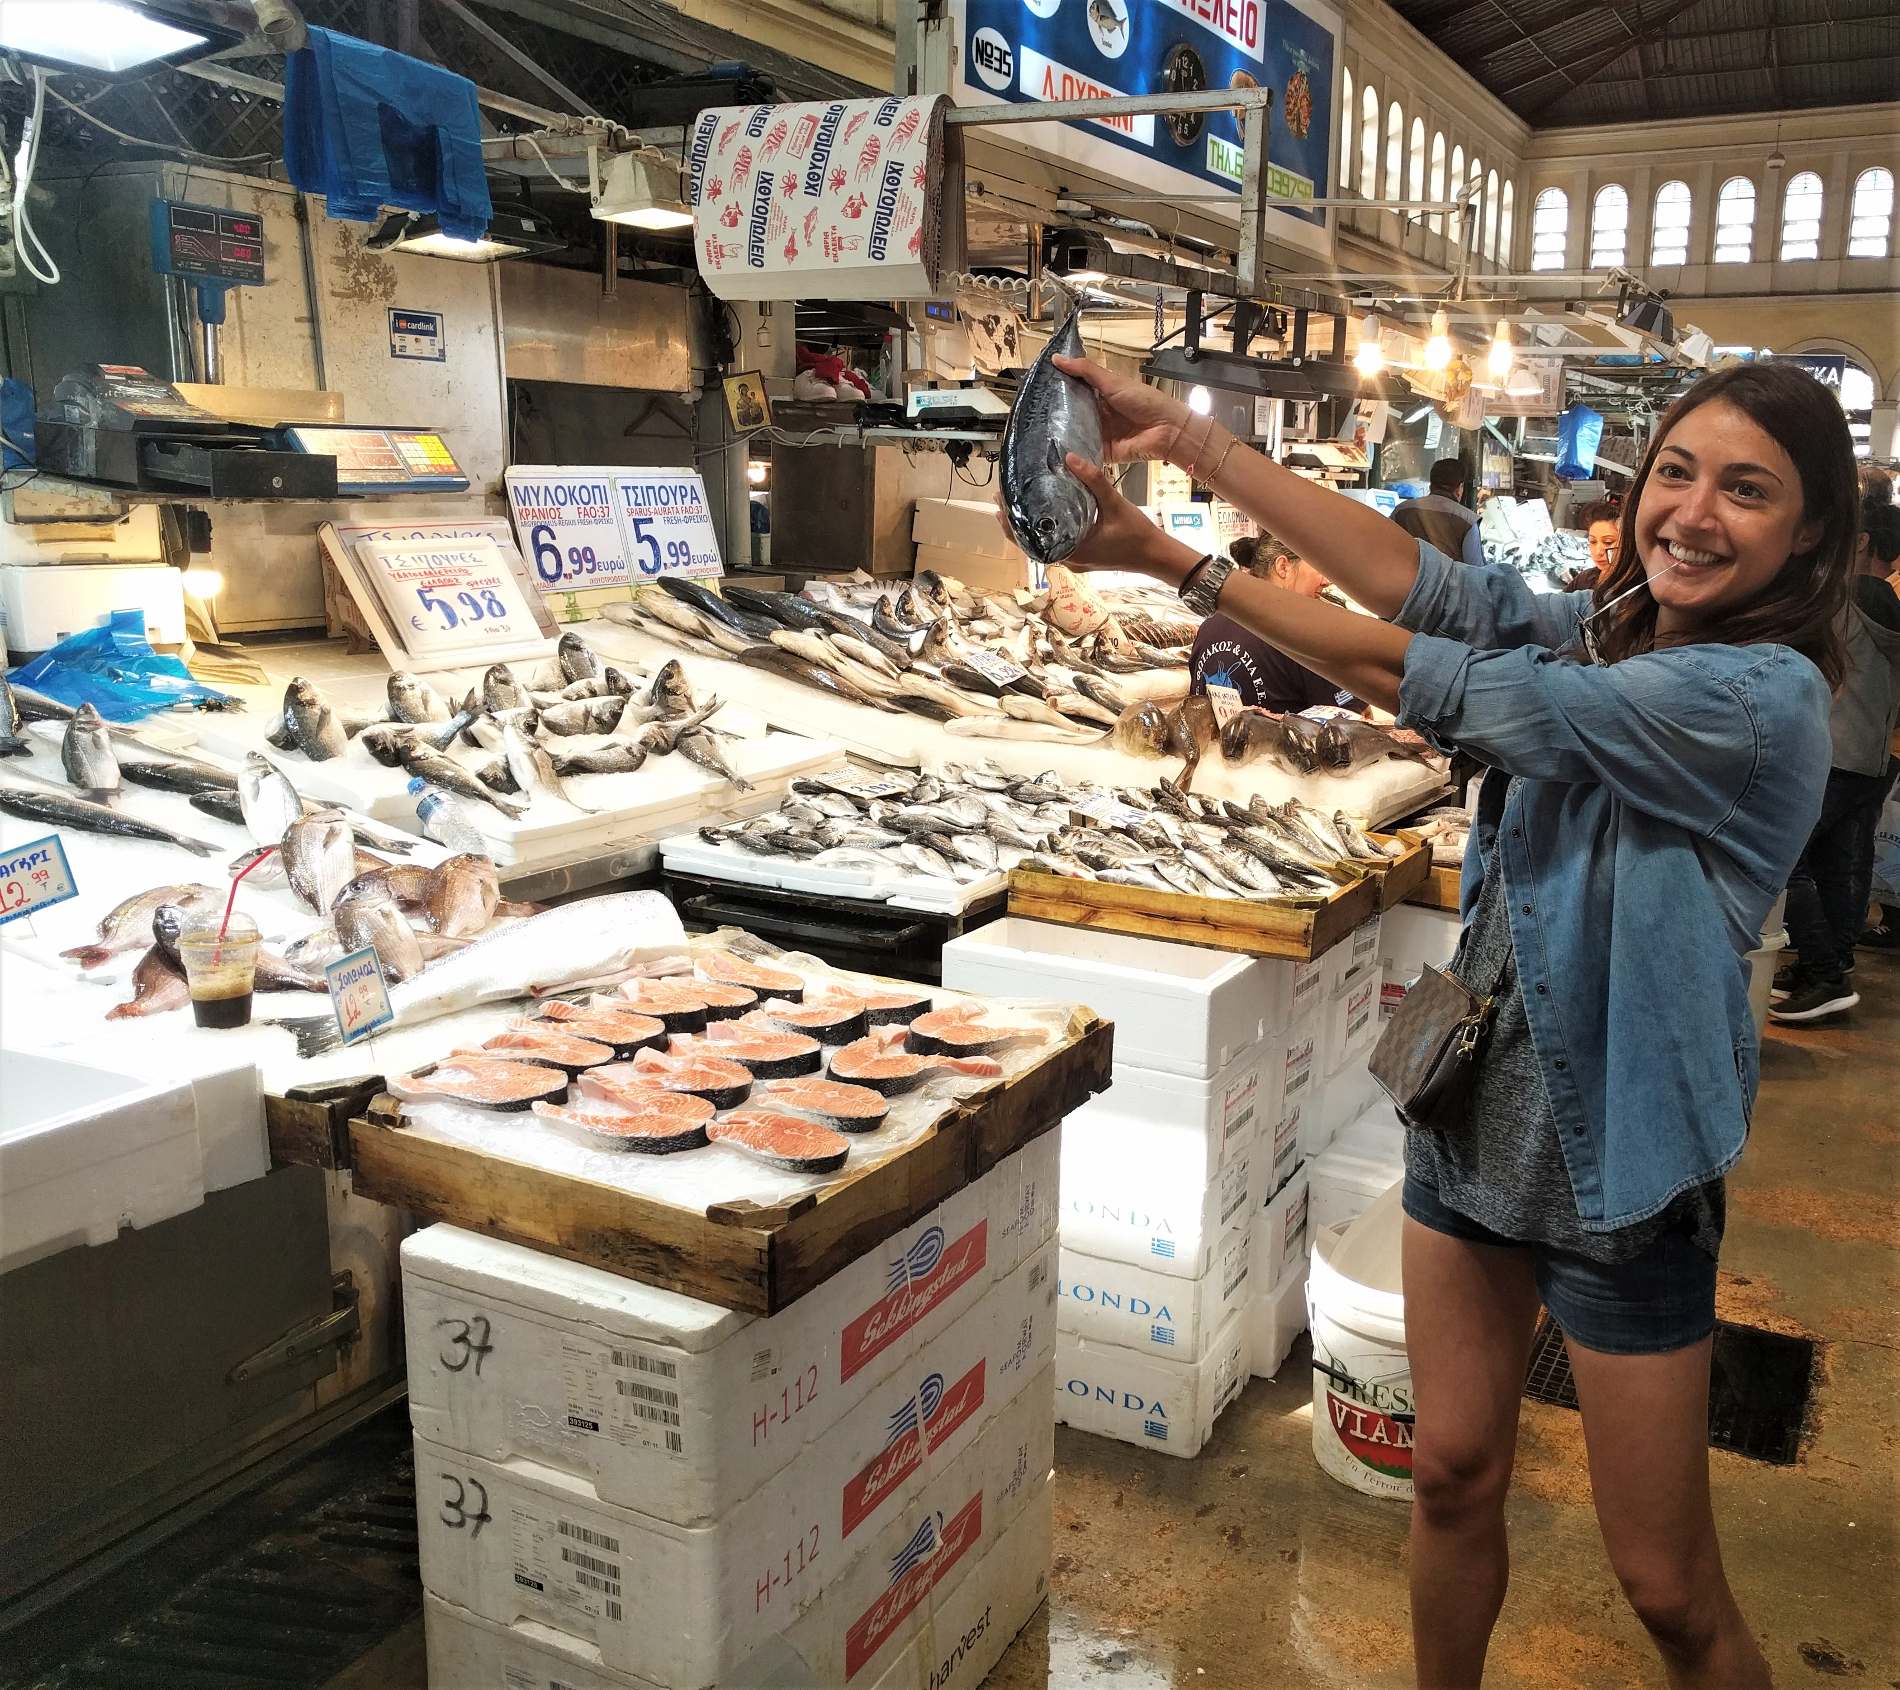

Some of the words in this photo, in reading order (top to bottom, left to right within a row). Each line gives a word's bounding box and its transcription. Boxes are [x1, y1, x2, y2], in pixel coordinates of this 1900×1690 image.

[1182, 0, 1257, 48] ΛΕΙΟ
[803, 104, 844, 197] ΙΧΘΥΟΠΩΛΕΙΟ
[750, 171, 775, 268] ΙΧΘΥΟΠΩΛΕΙΟ
[870, 161, 905, 261] ΙΧΘΥΟΠΩΛΕΙΟ
[407, 321, 434, 331] cardlink
[513, 485, 609, 507] ΜΥΛΟΚΟΠΙ
[518, 507, 563, 520] ΚΡΑΝΙΟΣ
[621, 485, 701, 507] ΤΣΙΠΟΥΡΑ
[1232, 644, 1241, 656] &
[1240, 651, 1257, 677] ΣΙΑ
[860, 1241, 973, 1353] Sekkingstad
[437, 1316, 494, 1376] 37
[753, 1364, 819, 1448] H-112
[1328, 1355, 1415, 1413] DRES
[436, 1473, 493, 1539] 37
[755, 1524, 820, 1615] H-112
